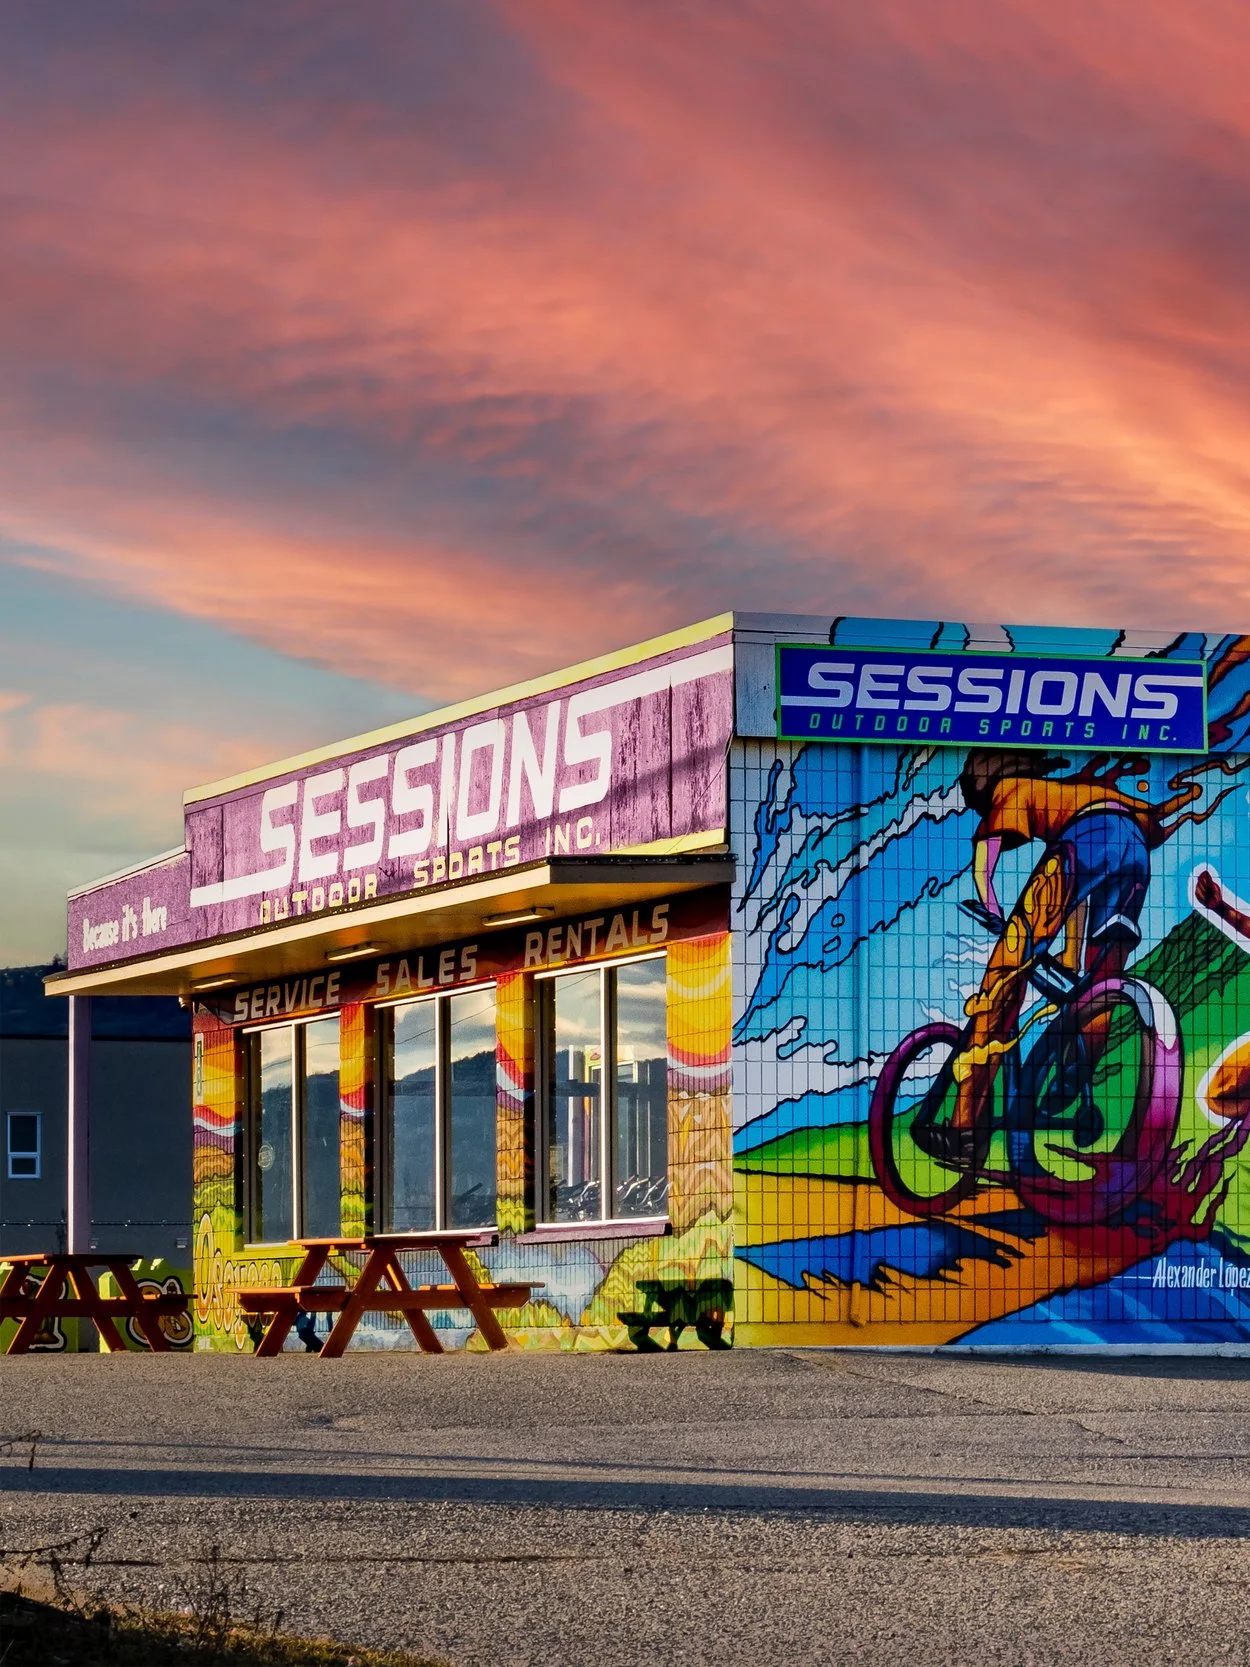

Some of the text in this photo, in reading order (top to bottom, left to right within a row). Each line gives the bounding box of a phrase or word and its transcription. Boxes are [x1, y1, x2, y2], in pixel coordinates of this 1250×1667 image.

[781, 662, 1203, 719] SESSIONS
[809, 713, 1178, 742] OUTDOOR SPORTS INC.
[260, 816, 601, 925] OUTDOOR SPORTS INC.
[233, 903, 670, 1023] SERVICE SALES RENTALS
[1152, 1257, 1217, 1289] Alexander
